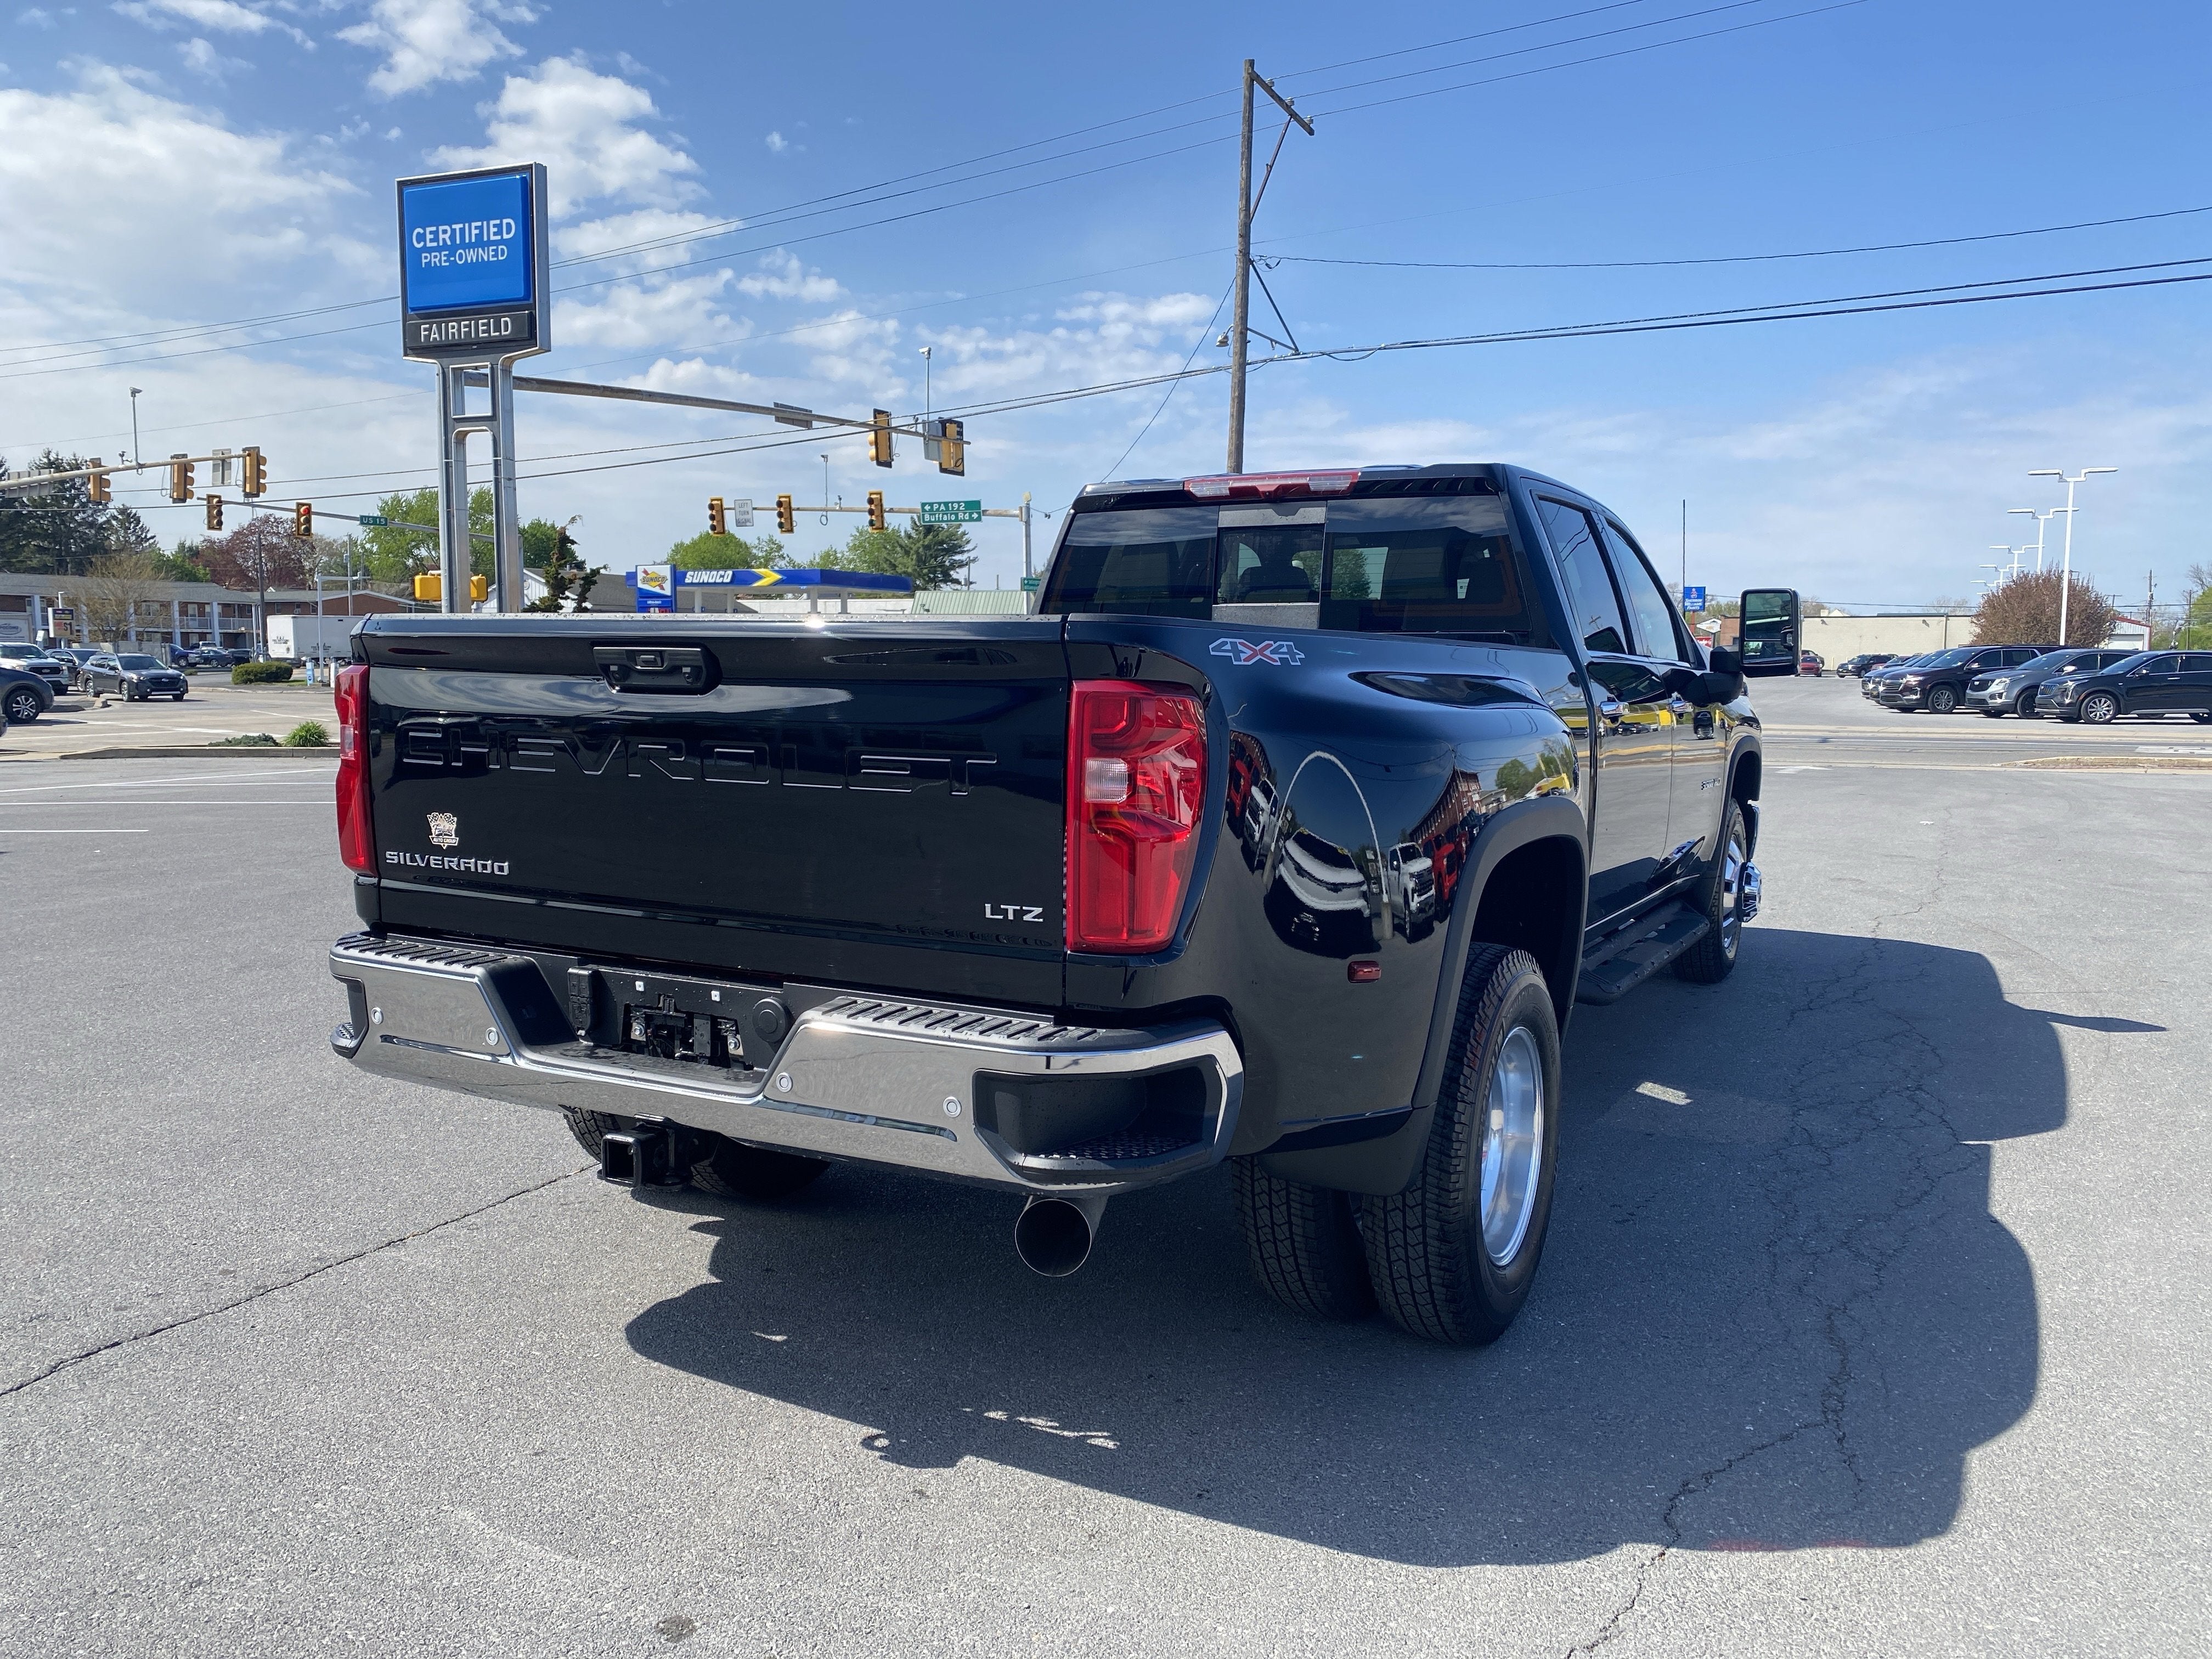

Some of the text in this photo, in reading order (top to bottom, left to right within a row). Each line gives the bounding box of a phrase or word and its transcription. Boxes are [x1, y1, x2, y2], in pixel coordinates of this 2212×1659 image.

[413, 218, 515, 248] CERTIFIED
[422, 245, 507, 268] PRE-OWNED
[420, 317, 512, 342] FAIRFIELD
[949, 502, 965, 511] 192
[924, 513, 955, 521] Buffalo
[642, 575, 665, 584] SUNOCO
[685, 571, 733, 583] SUNOCO
[400, 724, 999, 797] CHEVROLET
[385, 851, 510, 876] SILVERADO
[985, 904, 1043, 922] LTZ
